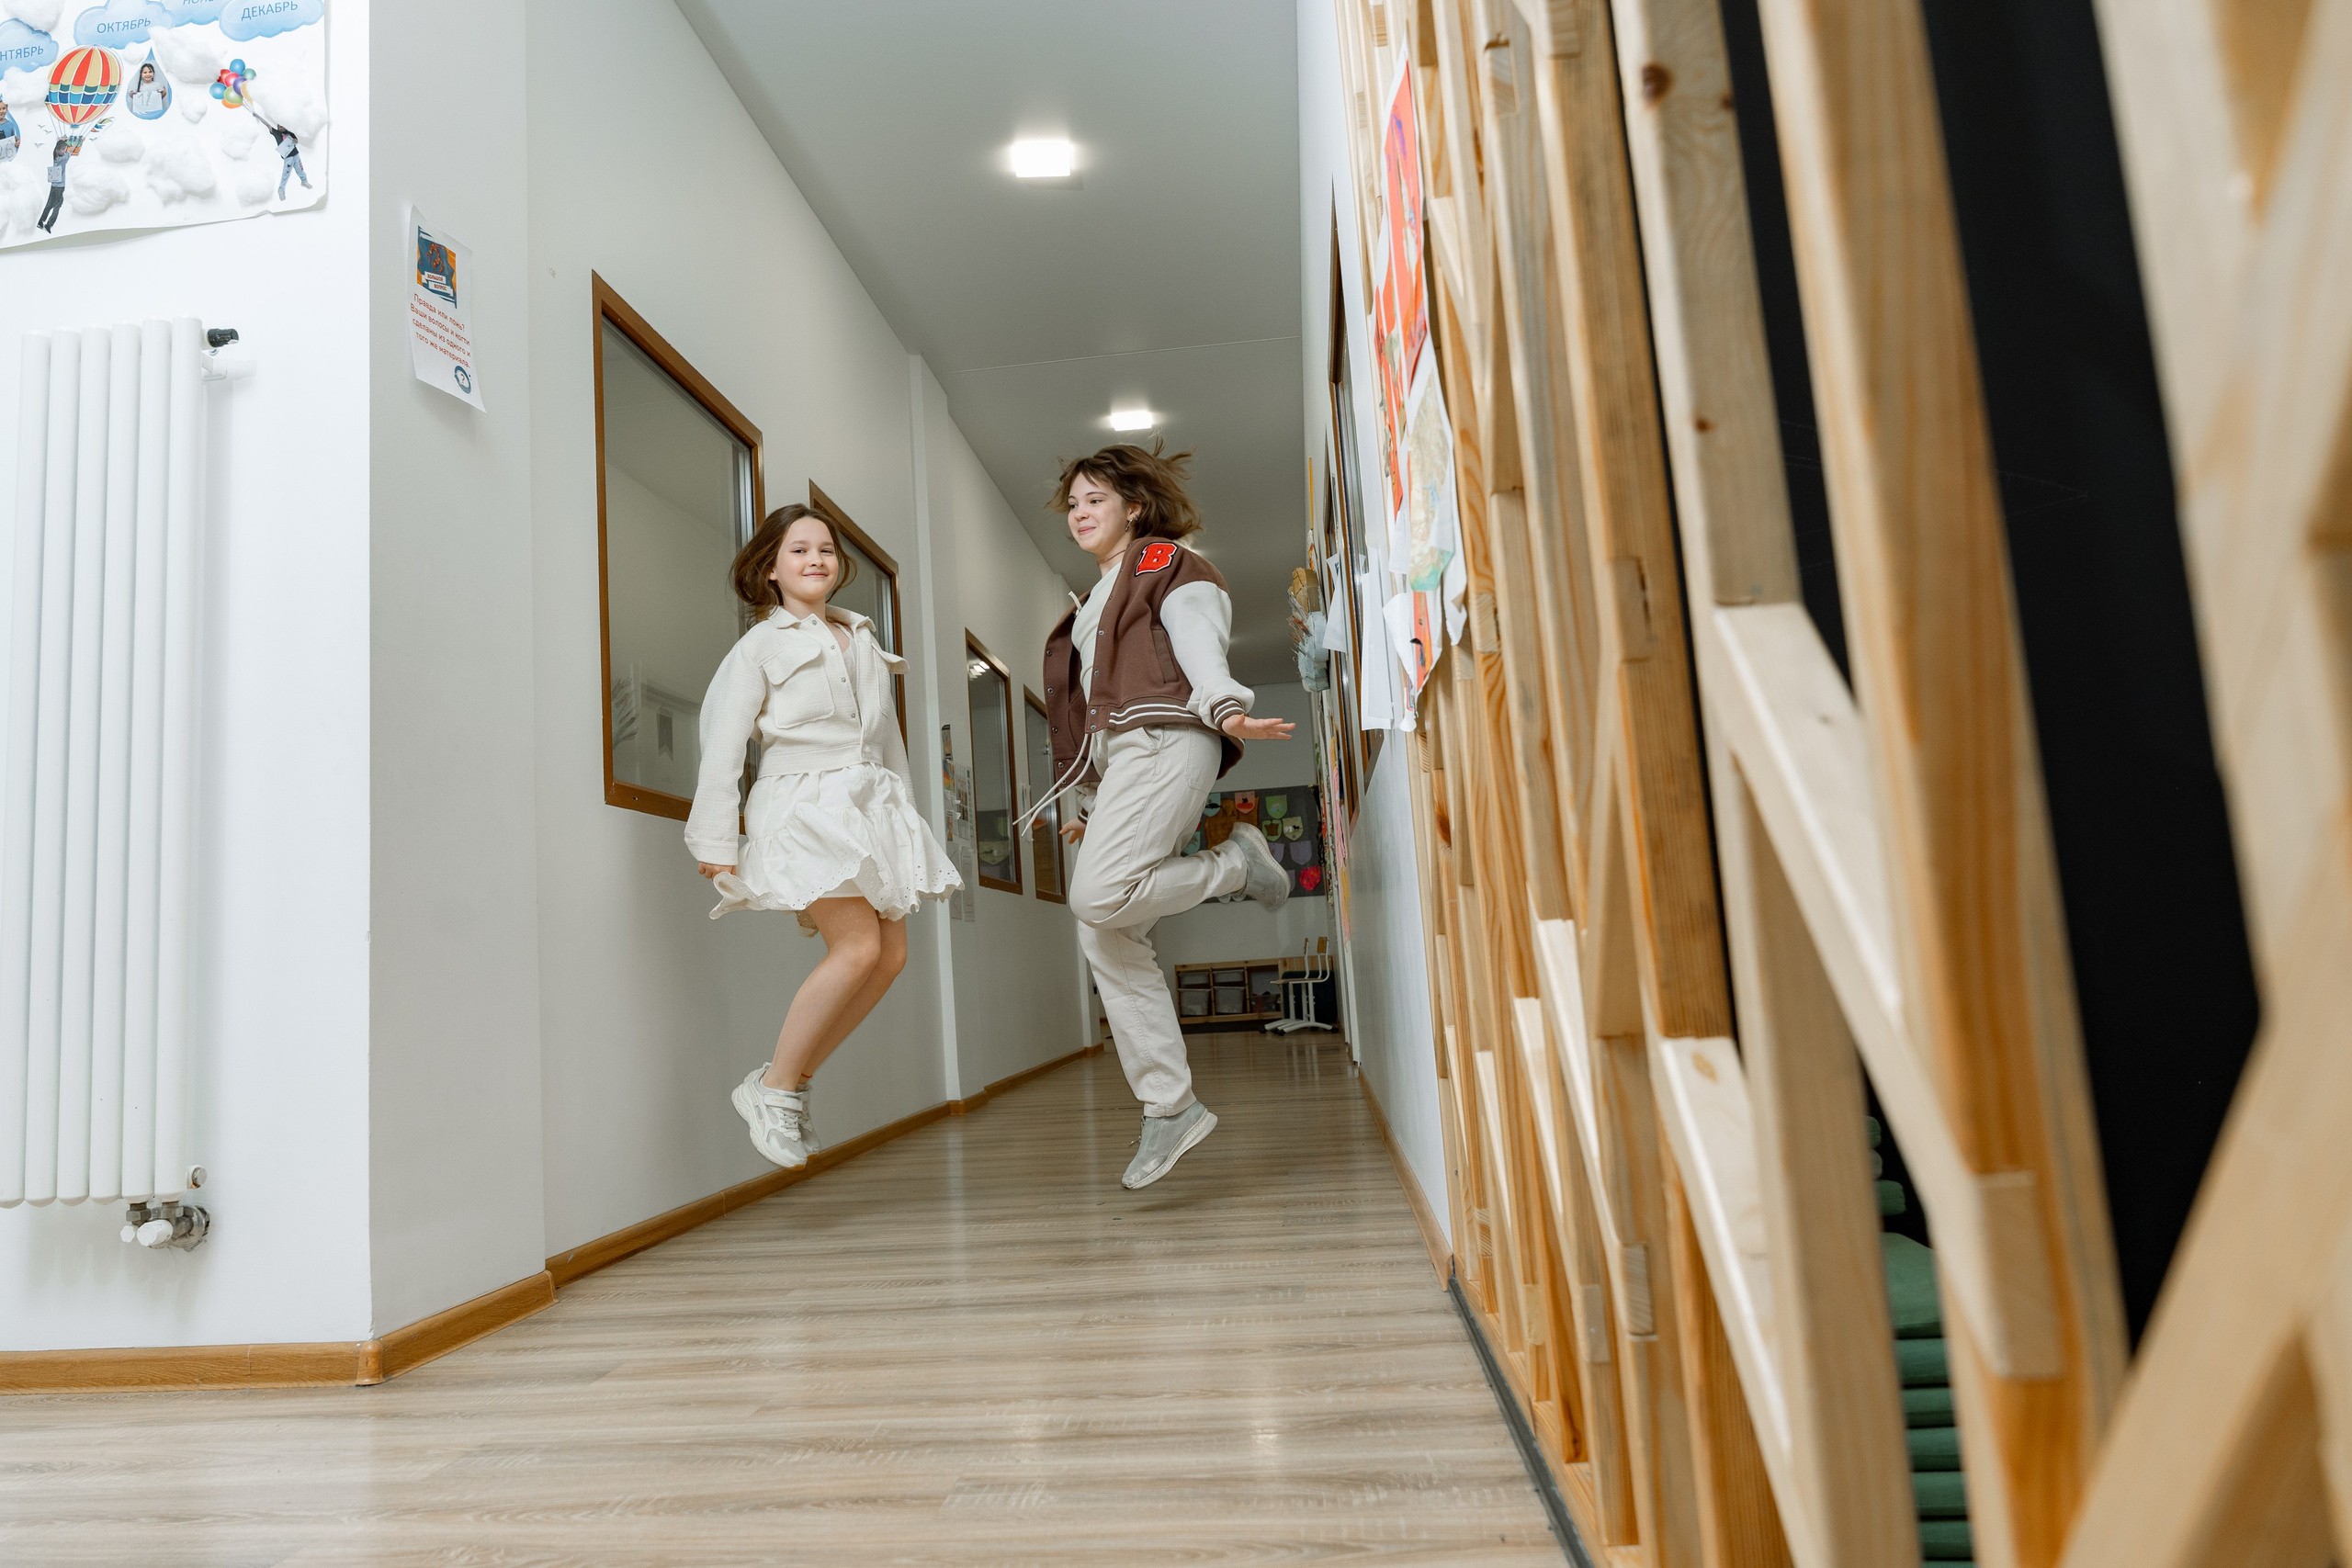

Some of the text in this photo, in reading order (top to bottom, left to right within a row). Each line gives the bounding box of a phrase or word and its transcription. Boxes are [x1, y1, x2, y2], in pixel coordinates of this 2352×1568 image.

[96, 17, 152, 34] ОКТЯБРЬ
[241, 1, 299, 21] ДЕКАБРЬ
[411, 303, 427, 320] Ваши
[428, 315, 449, 333] волосы
[456, 333, 470, 346] ногти
[414, 293, 465, 332] Правда или ложь?
[413, 319, 438, 338] сделаны
[438, 333, 446, 343] из
[447, 339, 466, 355] одного
[416, 332, 470, 368] того же материала.
[1135, 542, 1178, 577] B
